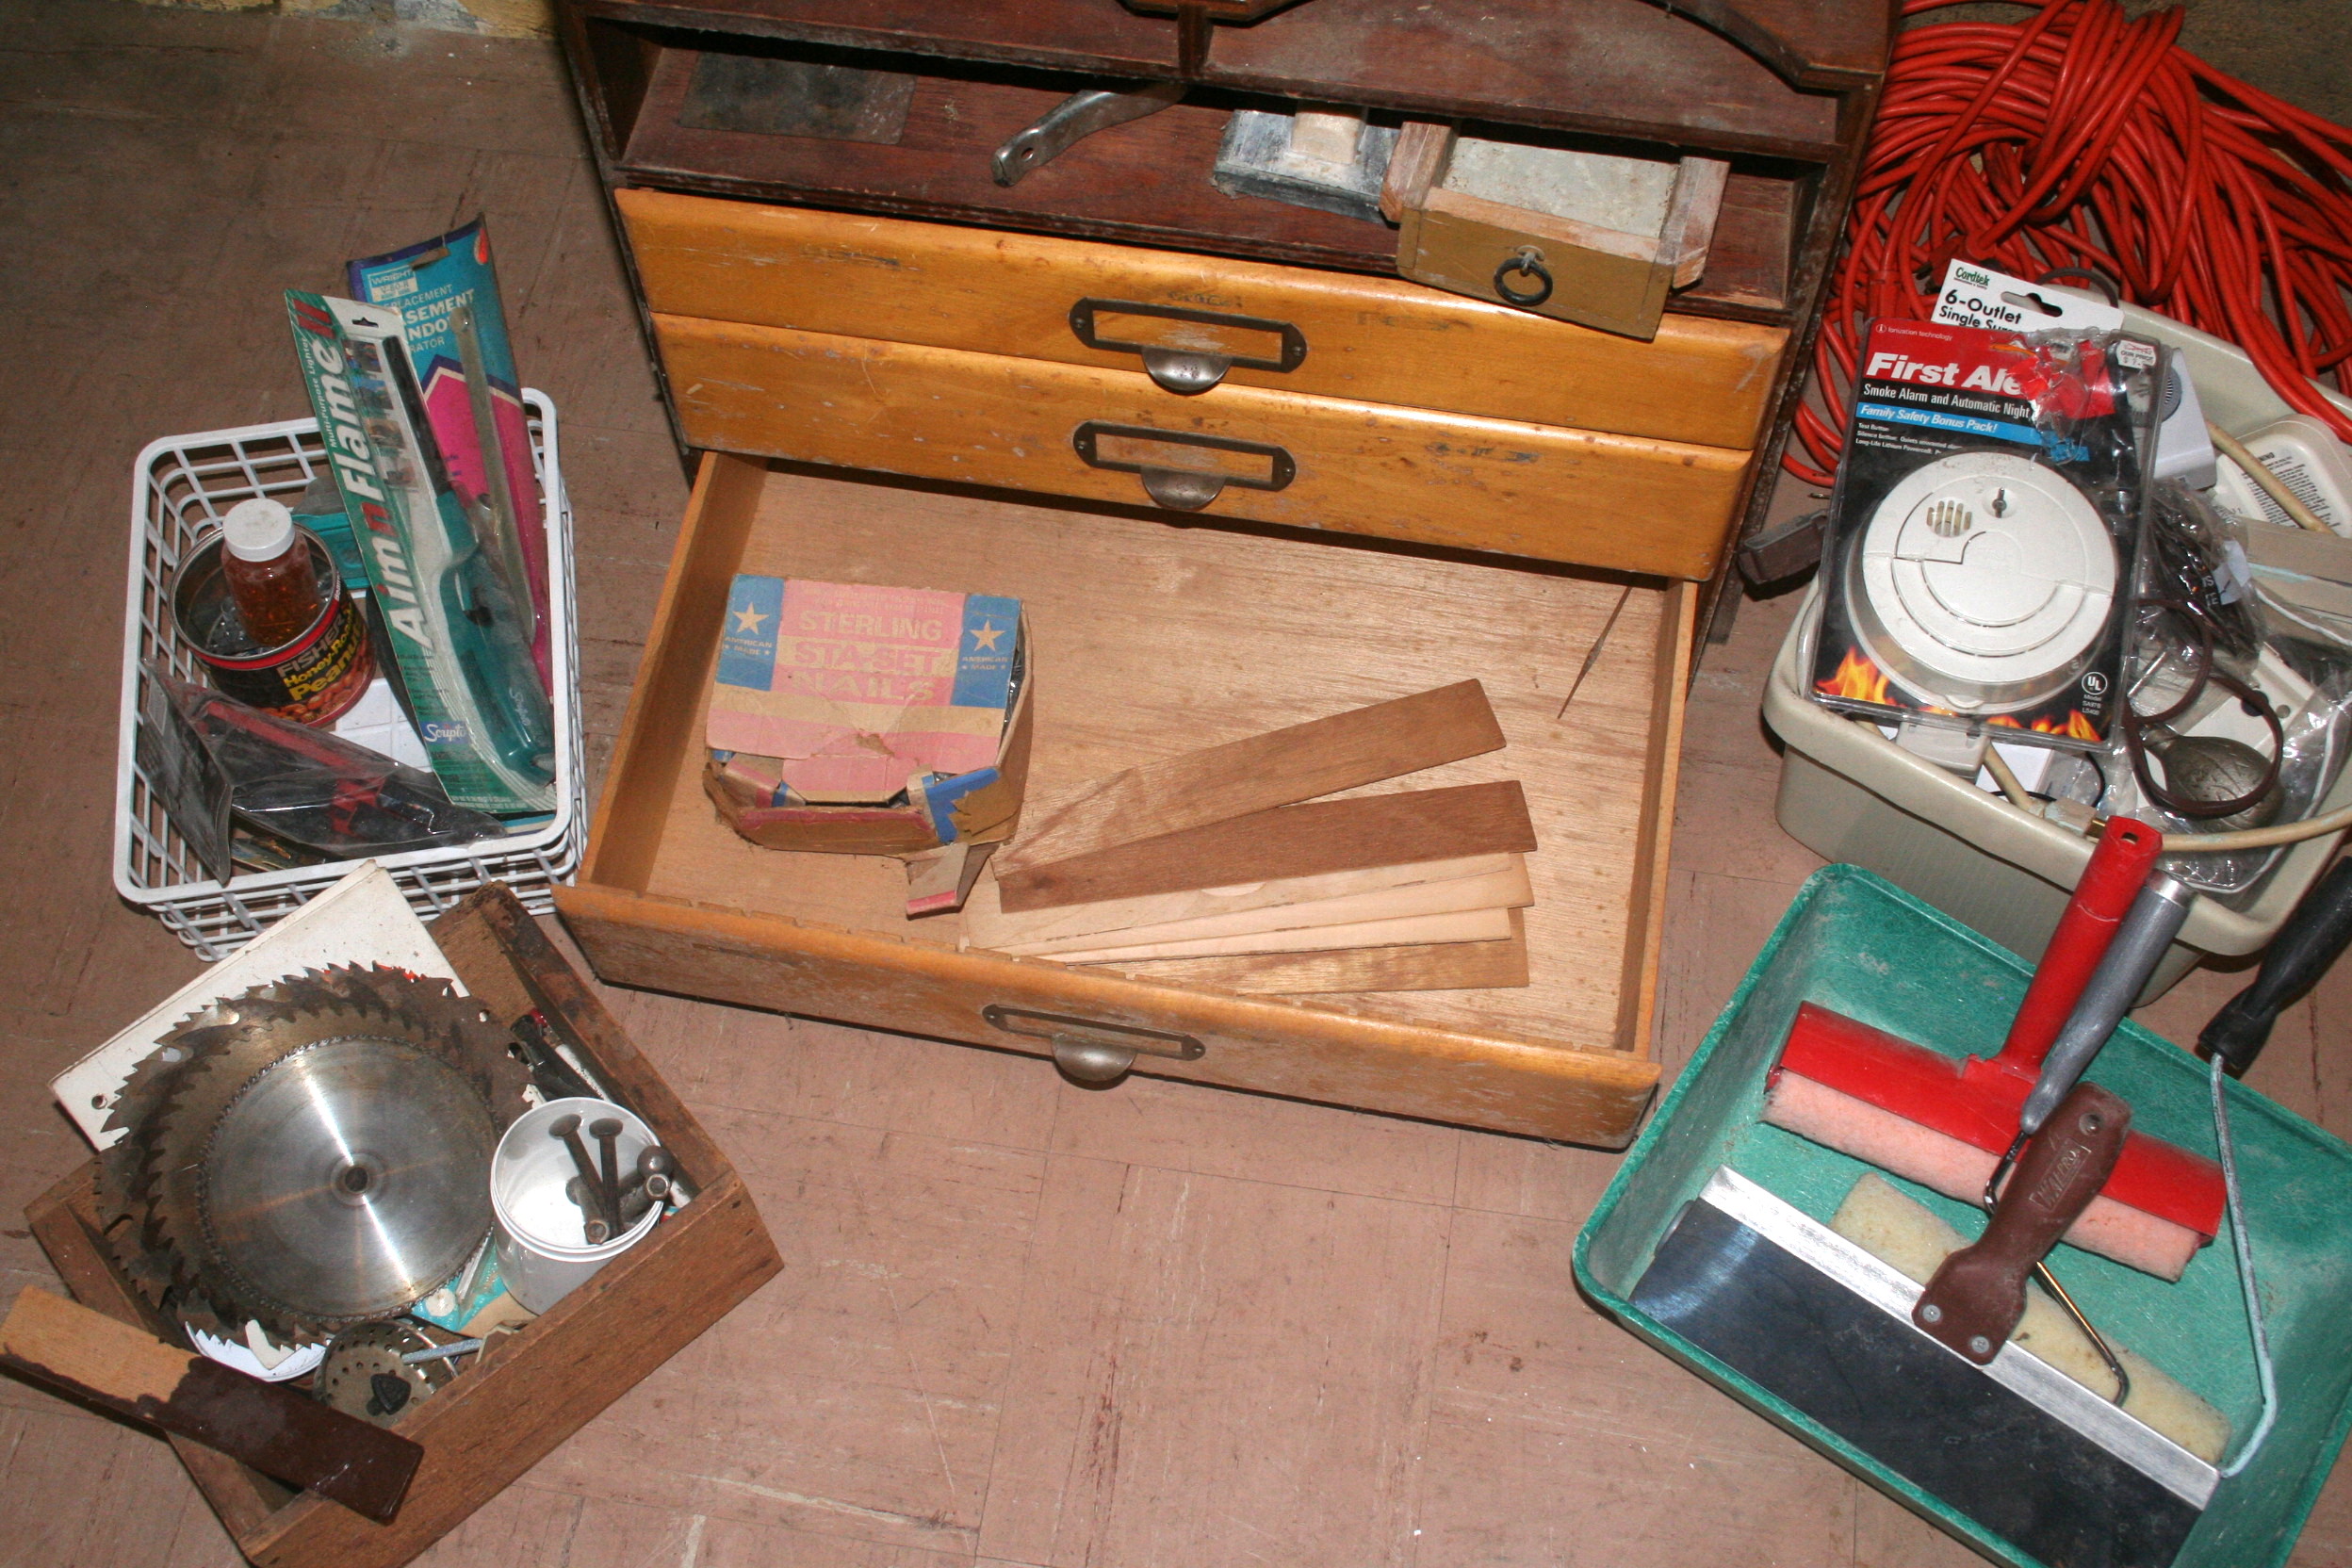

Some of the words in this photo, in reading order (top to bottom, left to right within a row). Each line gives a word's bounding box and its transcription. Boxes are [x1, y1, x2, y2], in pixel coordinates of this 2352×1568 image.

[384, 285, 452, 309] EPLACEMENT
[403, 288, 474, 325] SEMENT
[1945, 289, 2021, 324] 6-Outlet
[407, 316, 451, 341] NDO
[1939, 305, 1981, 327] Single
[410, 336, 445, 353] RATOR
[1919, 331, 1952, 341] technology
[1866, 351, 1959, 385] First
[1961, 365, 2021, 396] Ale
[1863, 384, 1896, 399] Smoke
[1899, 388, 1928, 403] Alarm
[1931, 393, 1949, 405] and
[1951, 396, 2001, 414] Automatic
[2003, 401, 2030, 419] Night
[312, 338, 384, 502] Flame
[1860, 407, 1895, 419] Family
[1896, 411, 1930, 425] Safety
[1932, 414, 1965, 428] Bonus
[1966, 419, 1998, 433] Pack!
[372, 536, 433, 650] Aim
[800, 611, 943, 642] STERLING
[276, 613, 346, 678] FISHER
[725, 637, 772, 648] AMERICAN
[794, 641, 943, 675] STA-SET
[791, 670, 937, 701] NAILS
[2087, 676, 2101, 691] UL
[424, 723, 467, 743] Scripto
